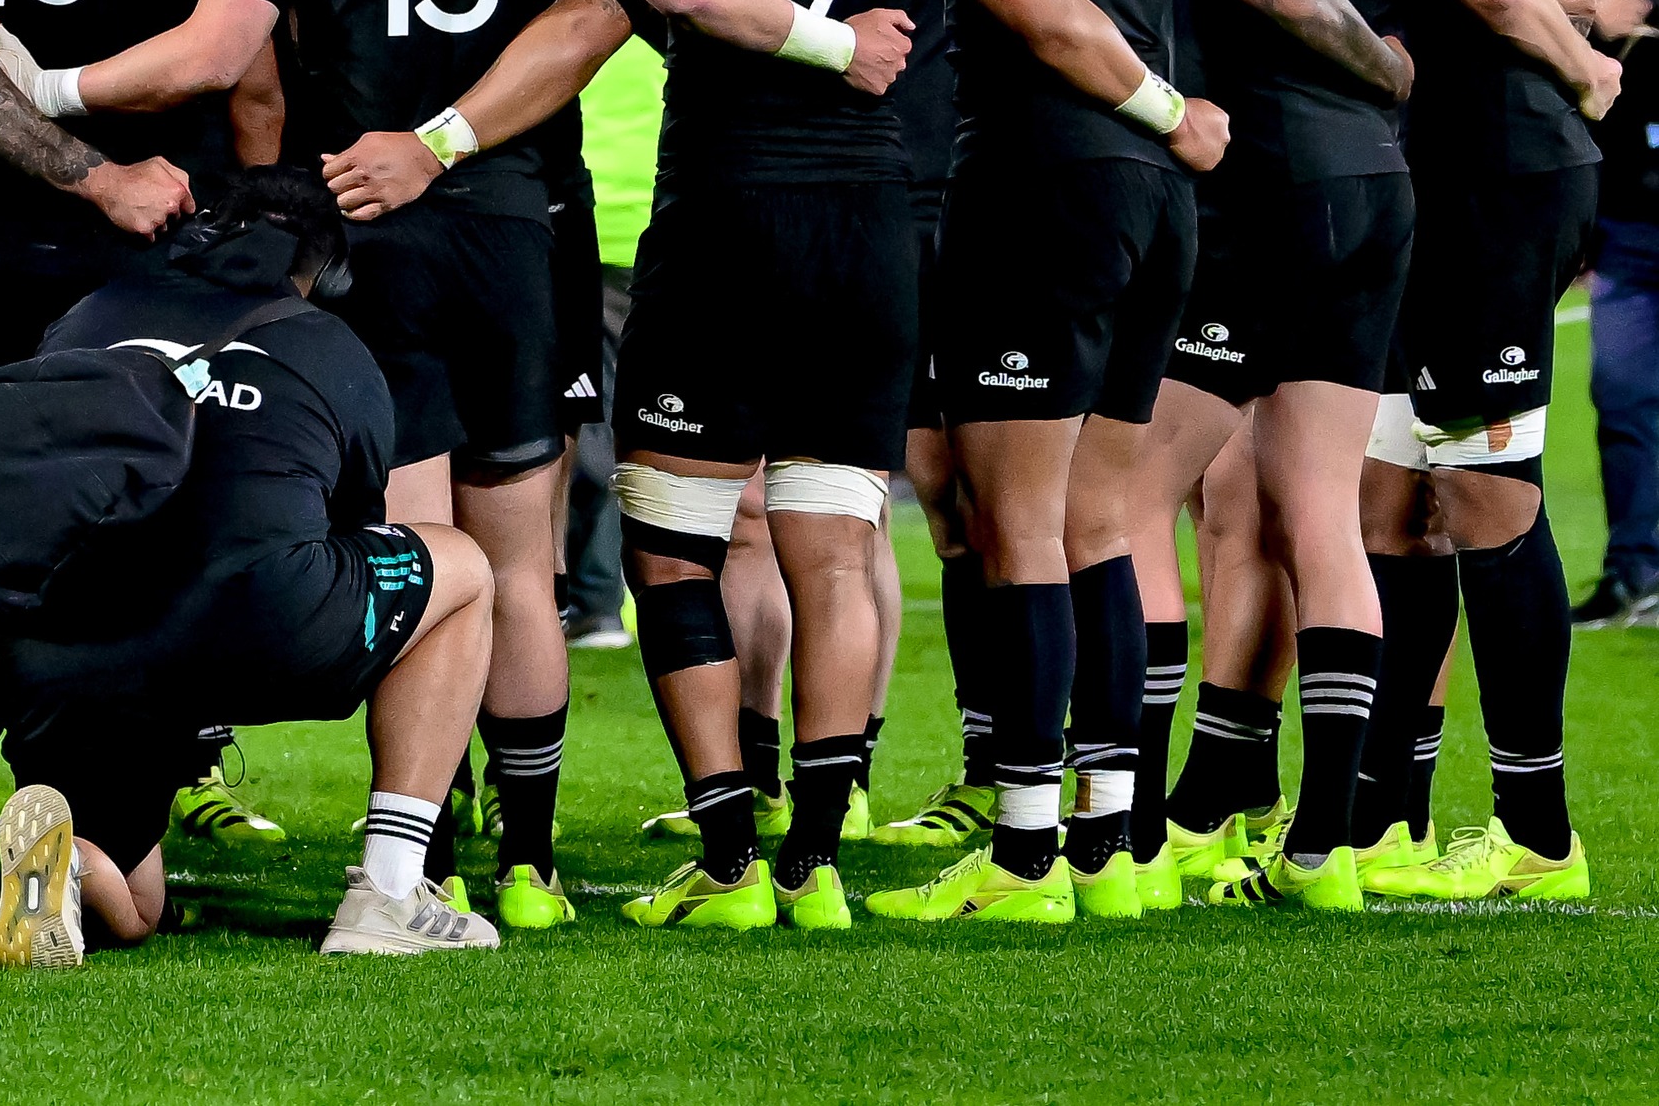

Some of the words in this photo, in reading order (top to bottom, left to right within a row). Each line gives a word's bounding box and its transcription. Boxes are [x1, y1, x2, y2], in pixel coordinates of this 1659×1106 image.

[1174, 337, 1246, 364] Gallagher
[978, 371, 1050, 391] Gallagher
[1482, 367, 1540, 384] Gallagher
[637, 408, 704, 434] Gallagher
